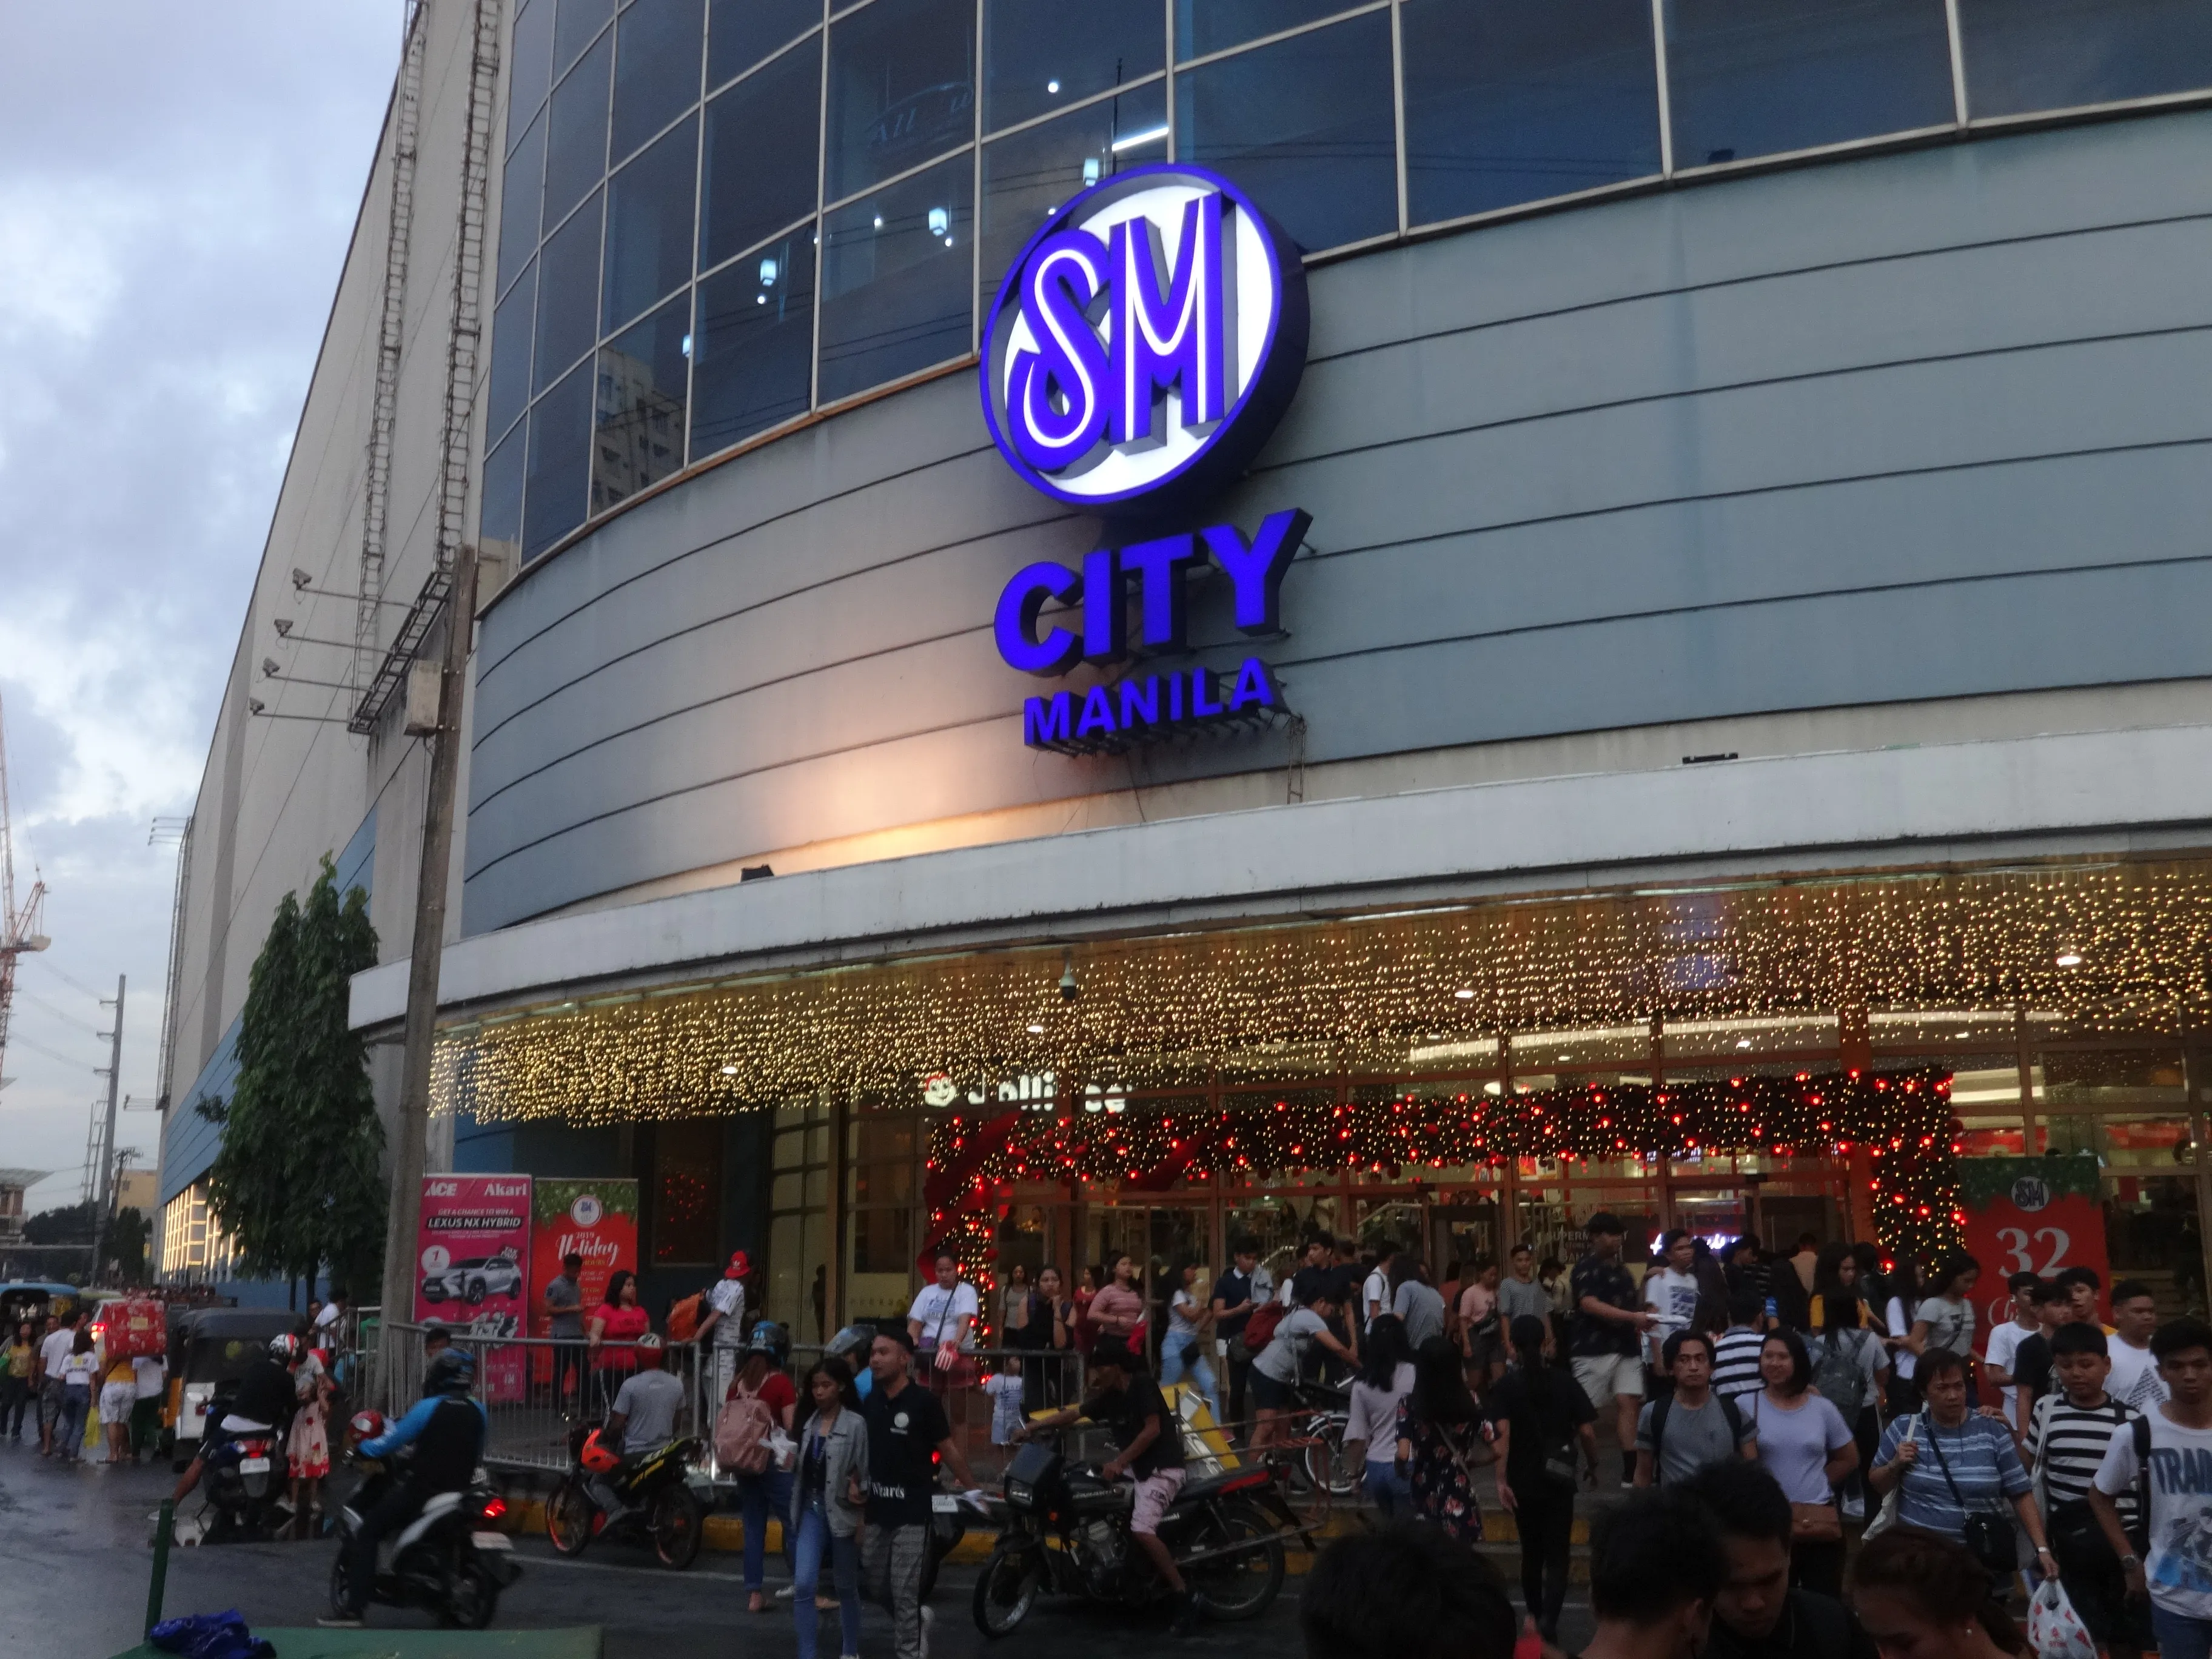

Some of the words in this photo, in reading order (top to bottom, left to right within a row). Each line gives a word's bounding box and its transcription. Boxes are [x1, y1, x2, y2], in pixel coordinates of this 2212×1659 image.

[1007, 190, 1226, 472] SM
[994, 508, 1309, 674] CITY
[1024, 657, 1277, 749] MANILA
[424, 1181, 458, 1196] ACE
[484, 1182, 527, 1196] Akari
[2015, 1181, 2045, 1207] SM
[427, 1218, 463, 1228] LEXUS
[464, 1218, 480, 1228] NX
[481, 1217, 521, 1228] HYBRID
[555, 1233, 620, 1267] Holiday
[1996, 1227, 2071, 1279] 32
